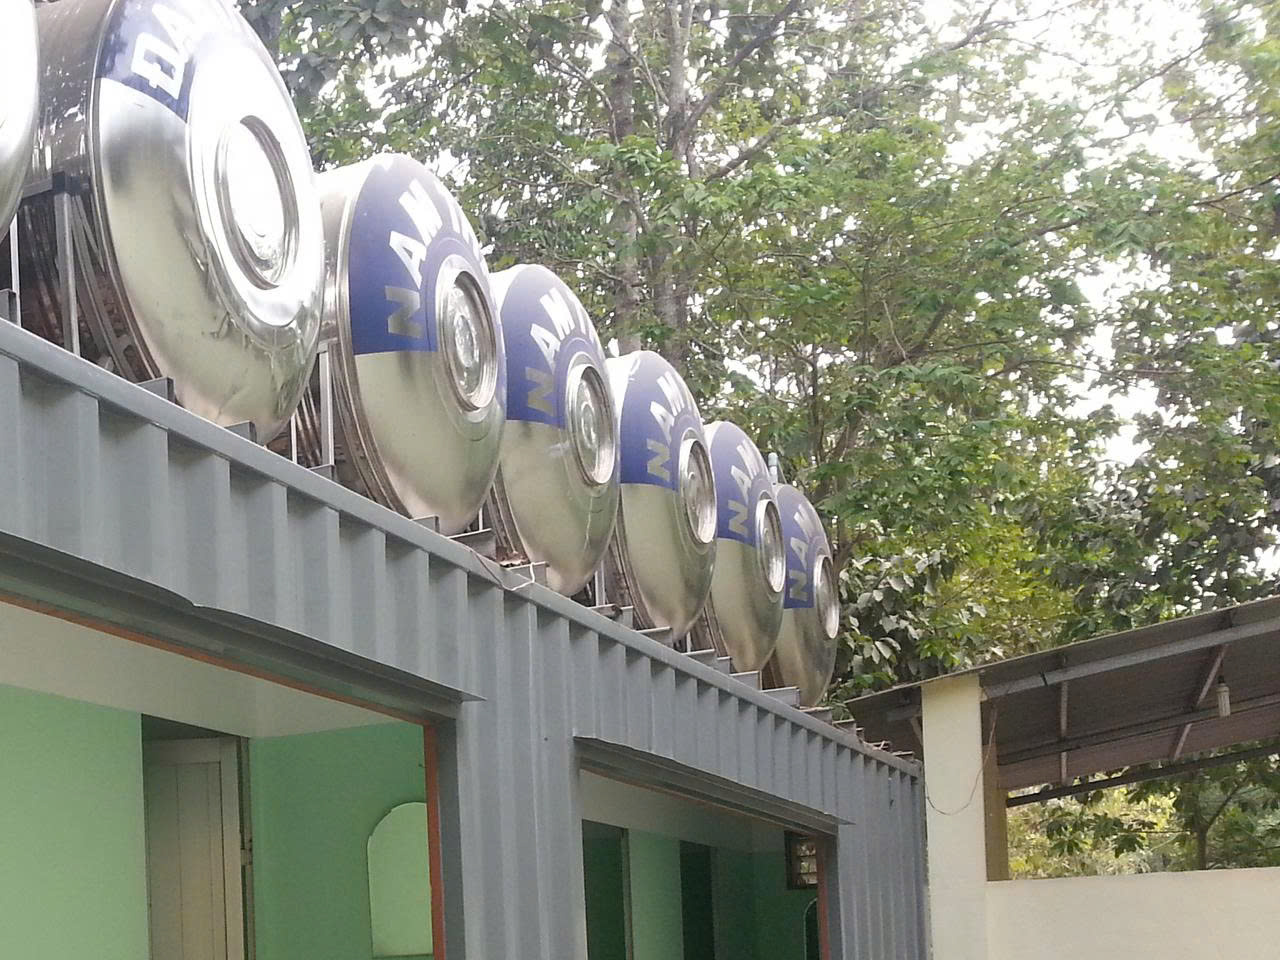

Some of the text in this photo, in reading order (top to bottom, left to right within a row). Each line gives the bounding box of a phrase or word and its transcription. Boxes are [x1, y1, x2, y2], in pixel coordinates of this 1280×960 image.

[385, 178, 443, 339] NAM
[525, 287, 575, 417] NAM
[646, 371, 685, 482] NAM
